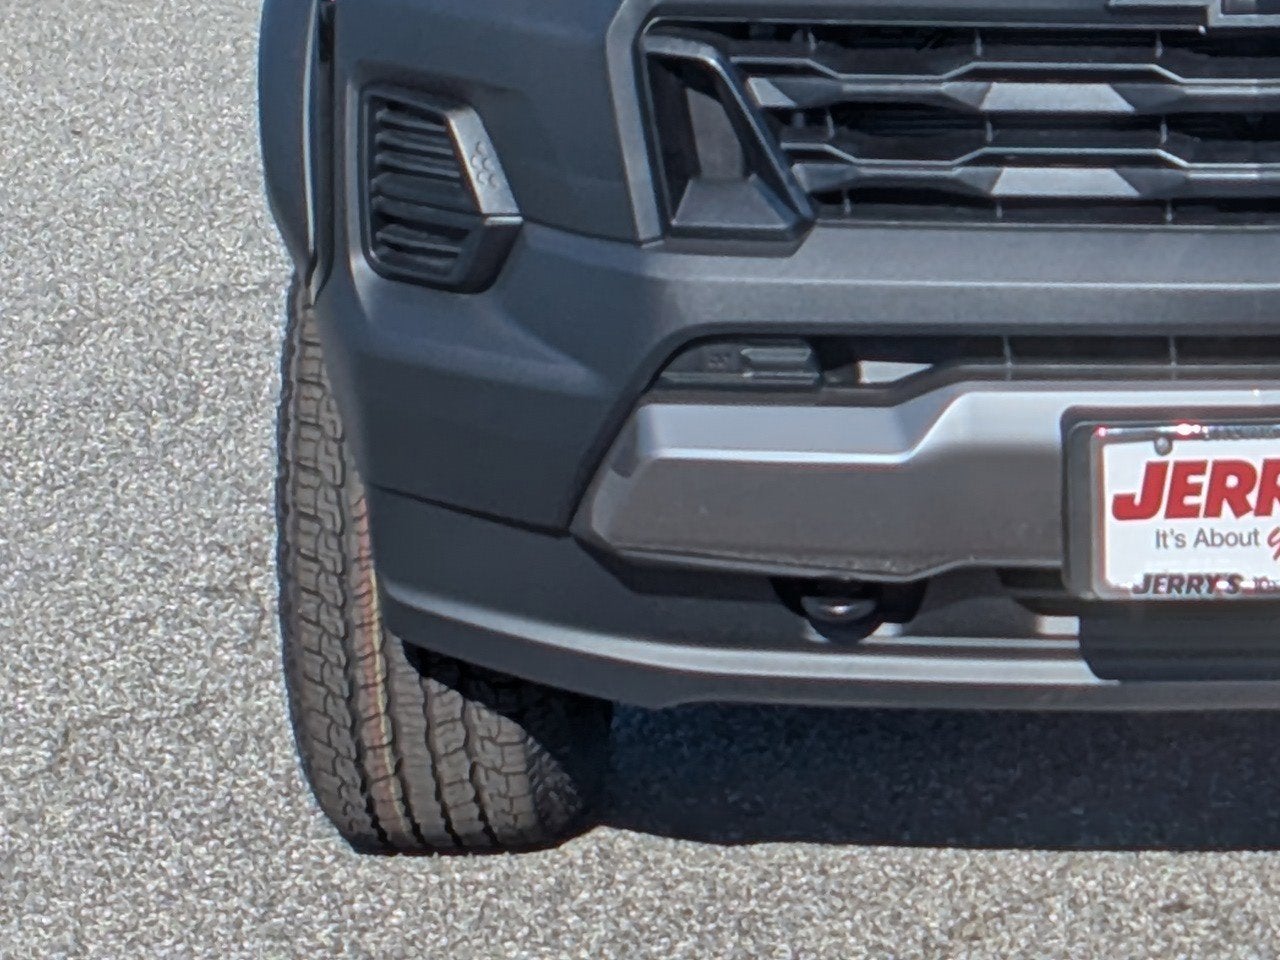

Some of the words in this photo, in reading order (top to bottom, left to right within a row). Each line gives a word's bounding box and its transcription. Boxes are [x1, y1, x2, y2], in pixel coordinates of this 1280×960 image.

[1155, 527, 1187, 549] It's
[1193, 527, 1261, 548] About
[1131, 572, 1244, 595] JERRY'S
